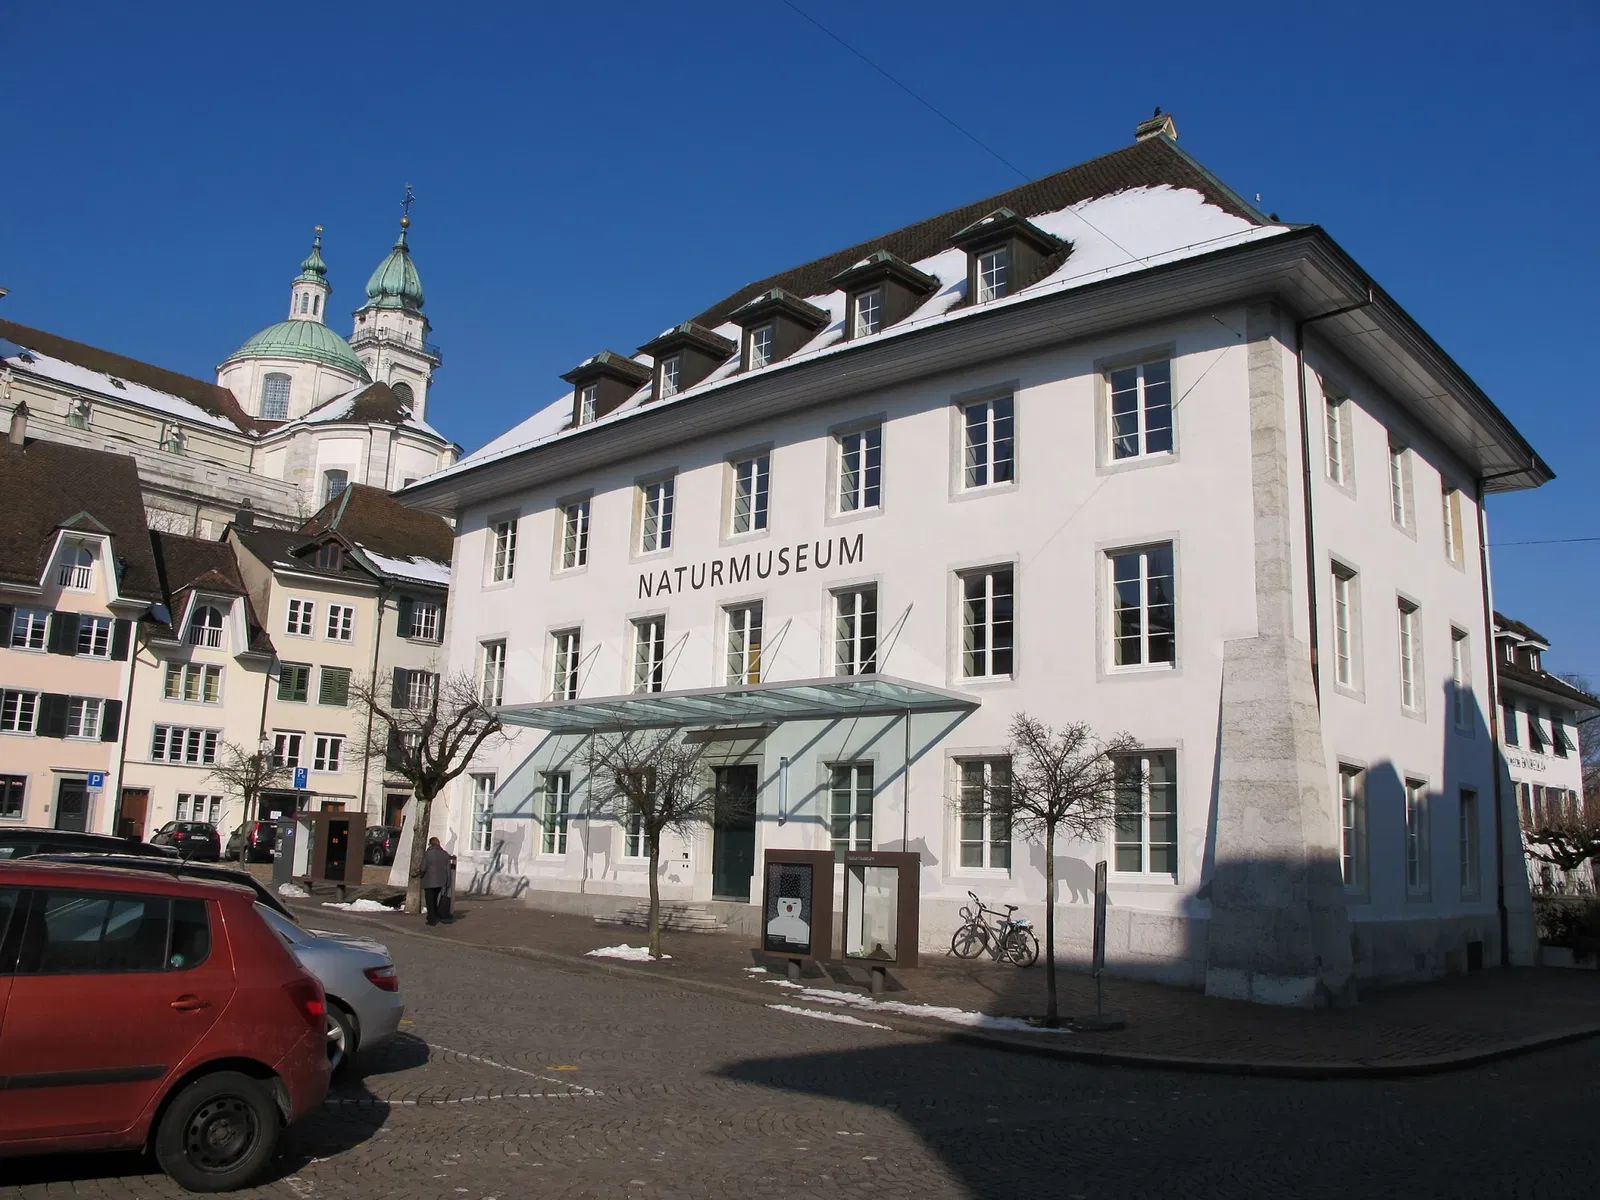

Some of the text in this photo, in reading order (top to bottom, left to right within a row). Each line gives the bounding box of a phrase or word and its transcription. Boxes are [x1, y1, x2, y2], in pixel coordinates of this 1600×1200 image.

[638, 533, 864, 599] NATURMUSEUM
[298, 769, 304, 777] P
[92, 775, 100, 785] P
